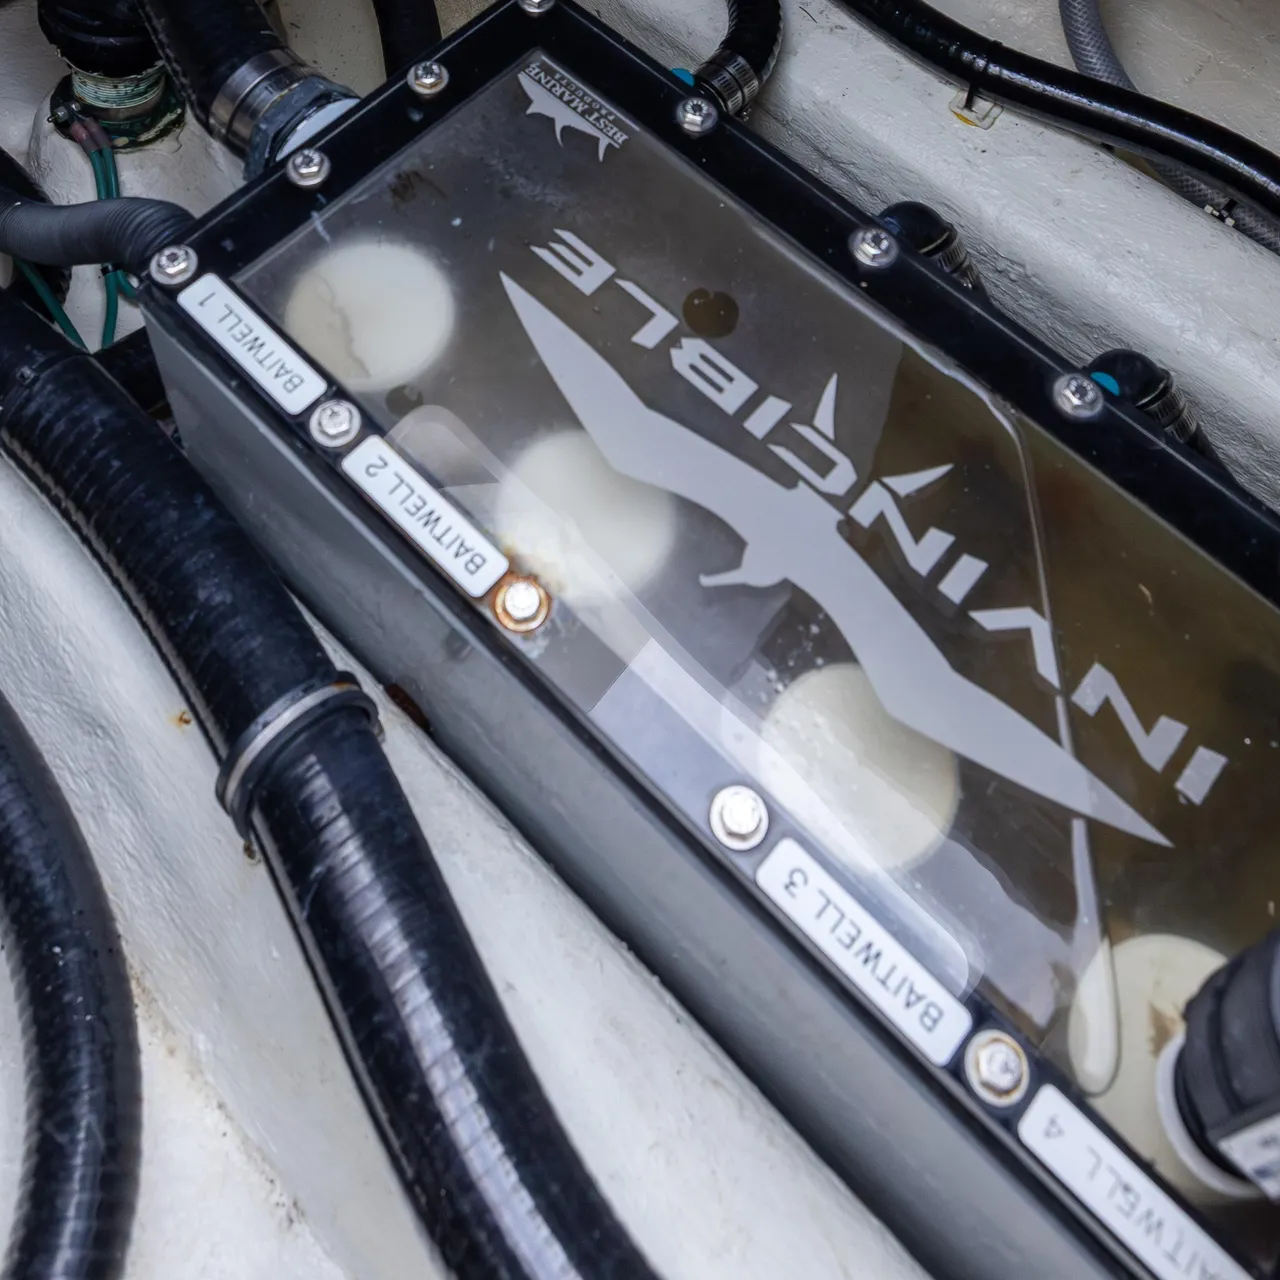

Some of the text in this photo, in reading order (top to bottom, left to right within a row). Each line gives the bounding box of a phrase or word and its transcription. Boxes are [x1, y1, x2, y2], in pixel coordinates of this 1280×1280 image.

[524, 62, 630, 145] BEST MARINE
[554, 72, 616, 122] PRODUCTS
[198, 291, 305, 395] BAITWELL 1
[364, 453, 488, 576] BAITWELL 2
[529, 228, 1228, 806] INVINCIBLE
[782, 866, 945, 1034] BAITWELL 3
[1043, 1114, 1065, 1140] 4
[1086, 1142, 1220, 1280] AITWELL
